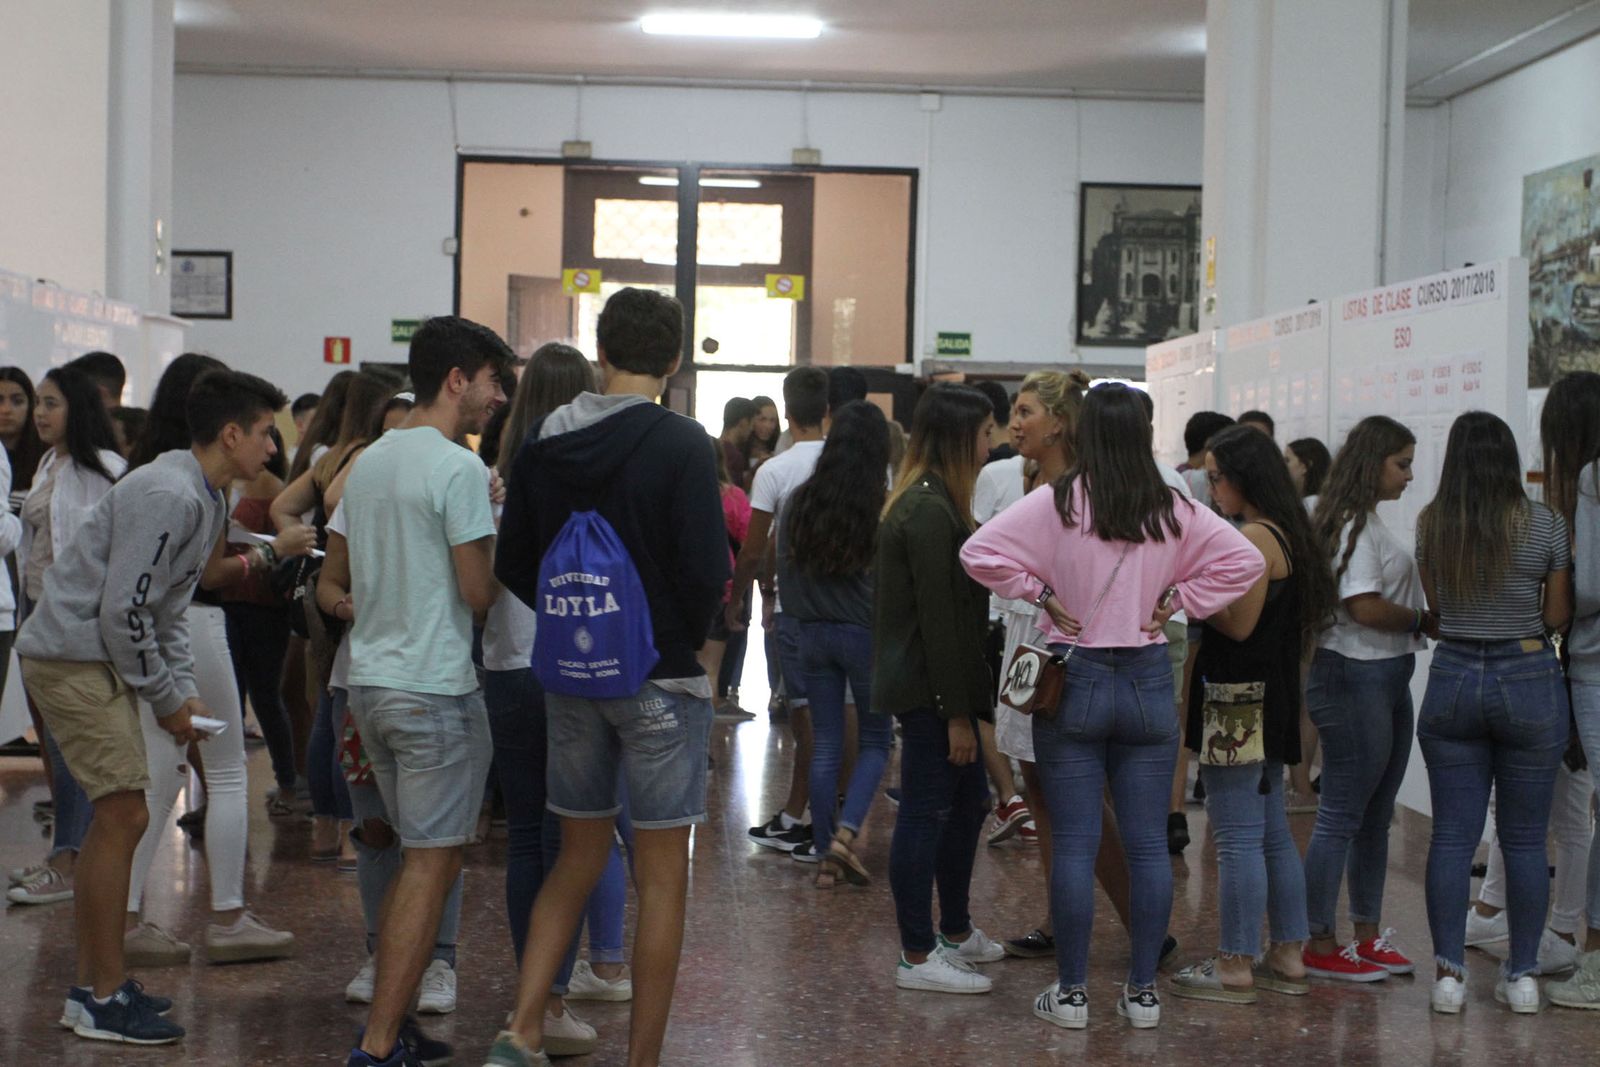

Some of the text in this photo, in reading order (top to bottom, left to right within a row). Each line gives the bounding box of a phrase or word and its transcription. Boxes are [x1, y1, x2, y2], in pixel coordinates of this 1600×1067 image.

[1343, 269, 1496, 321] LISTAS DE CLASE CURSO 2017/2018
[937, 338, 970, 349] SALIDA
[1394, 326, 1412, 349] ESO
[128, 531, 170, 678] 1991
[588, 658, 620, 669] SEVILLA
[595, 668, 621, 678] ROMA
